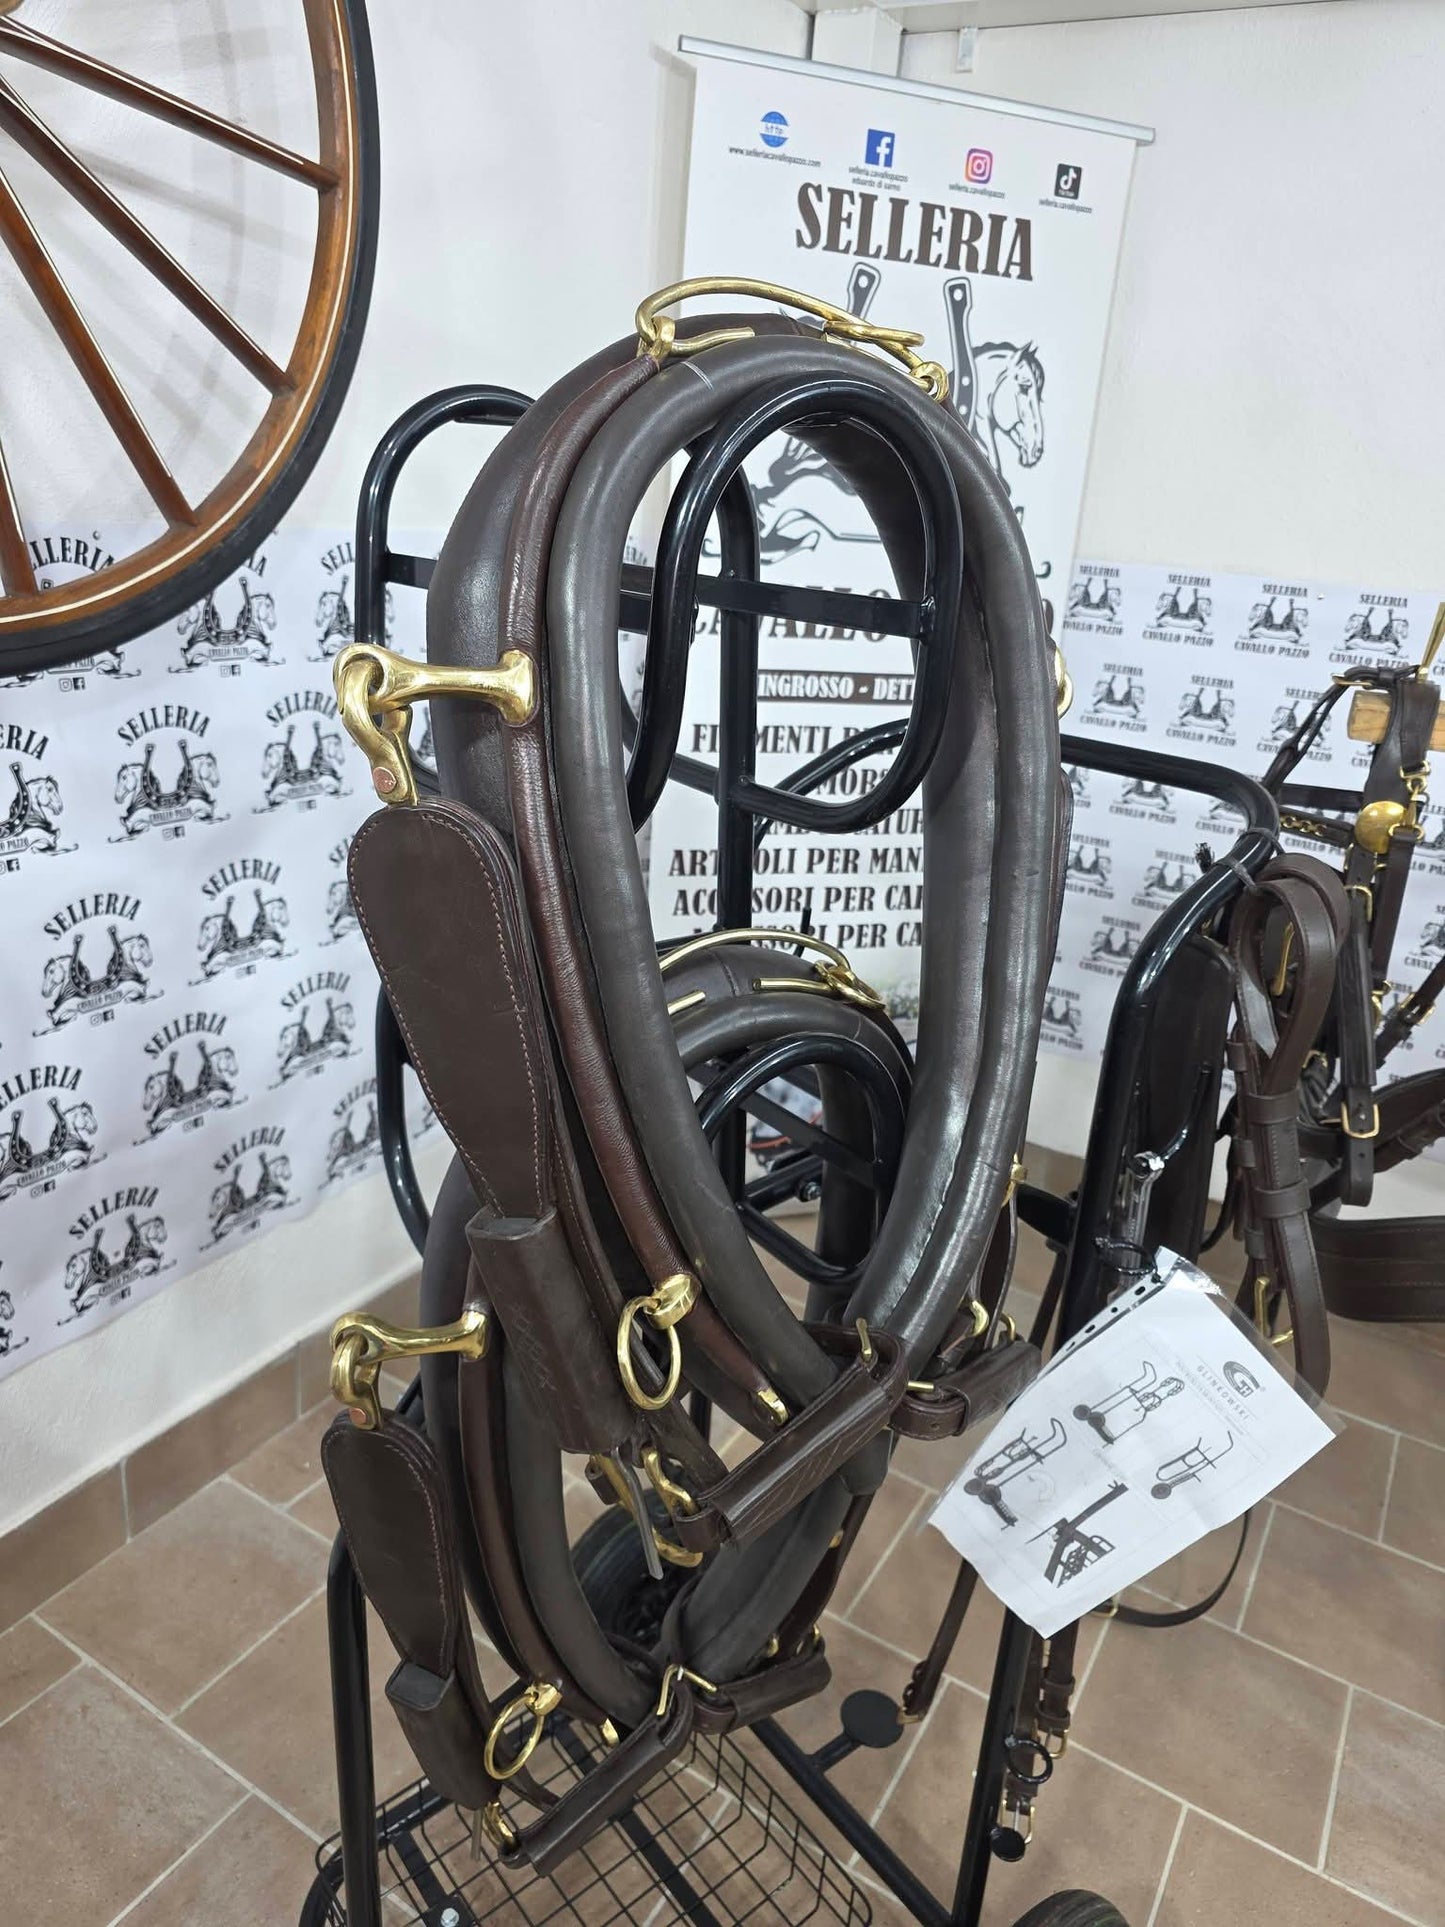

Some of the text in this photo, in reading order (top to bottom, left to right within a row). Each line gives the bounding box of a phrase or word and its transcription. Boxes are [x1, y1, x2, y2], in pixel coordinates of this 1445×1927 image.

[795, 181, 1034, 282] SELLERIA
[321, 542, 355, 576] SELL
[757, 673, 856, 701] INGROSSO
[117, 704, 210, 748] SELLERIA
[202, 858, 282, 901] SELLERIA
[668, 846, 923, 877] ARTOLI PER MAN
[43, 892, 142, 941] SELLERIA
[672, 886, 815, 916] ACCSORI
[822, 886, 877, 913] PER
[836, 922, 888, 950] PER
[143, 1011, 227, 1061] SELLERIA
[68, 1185, 159, 1240] SELLERIA
